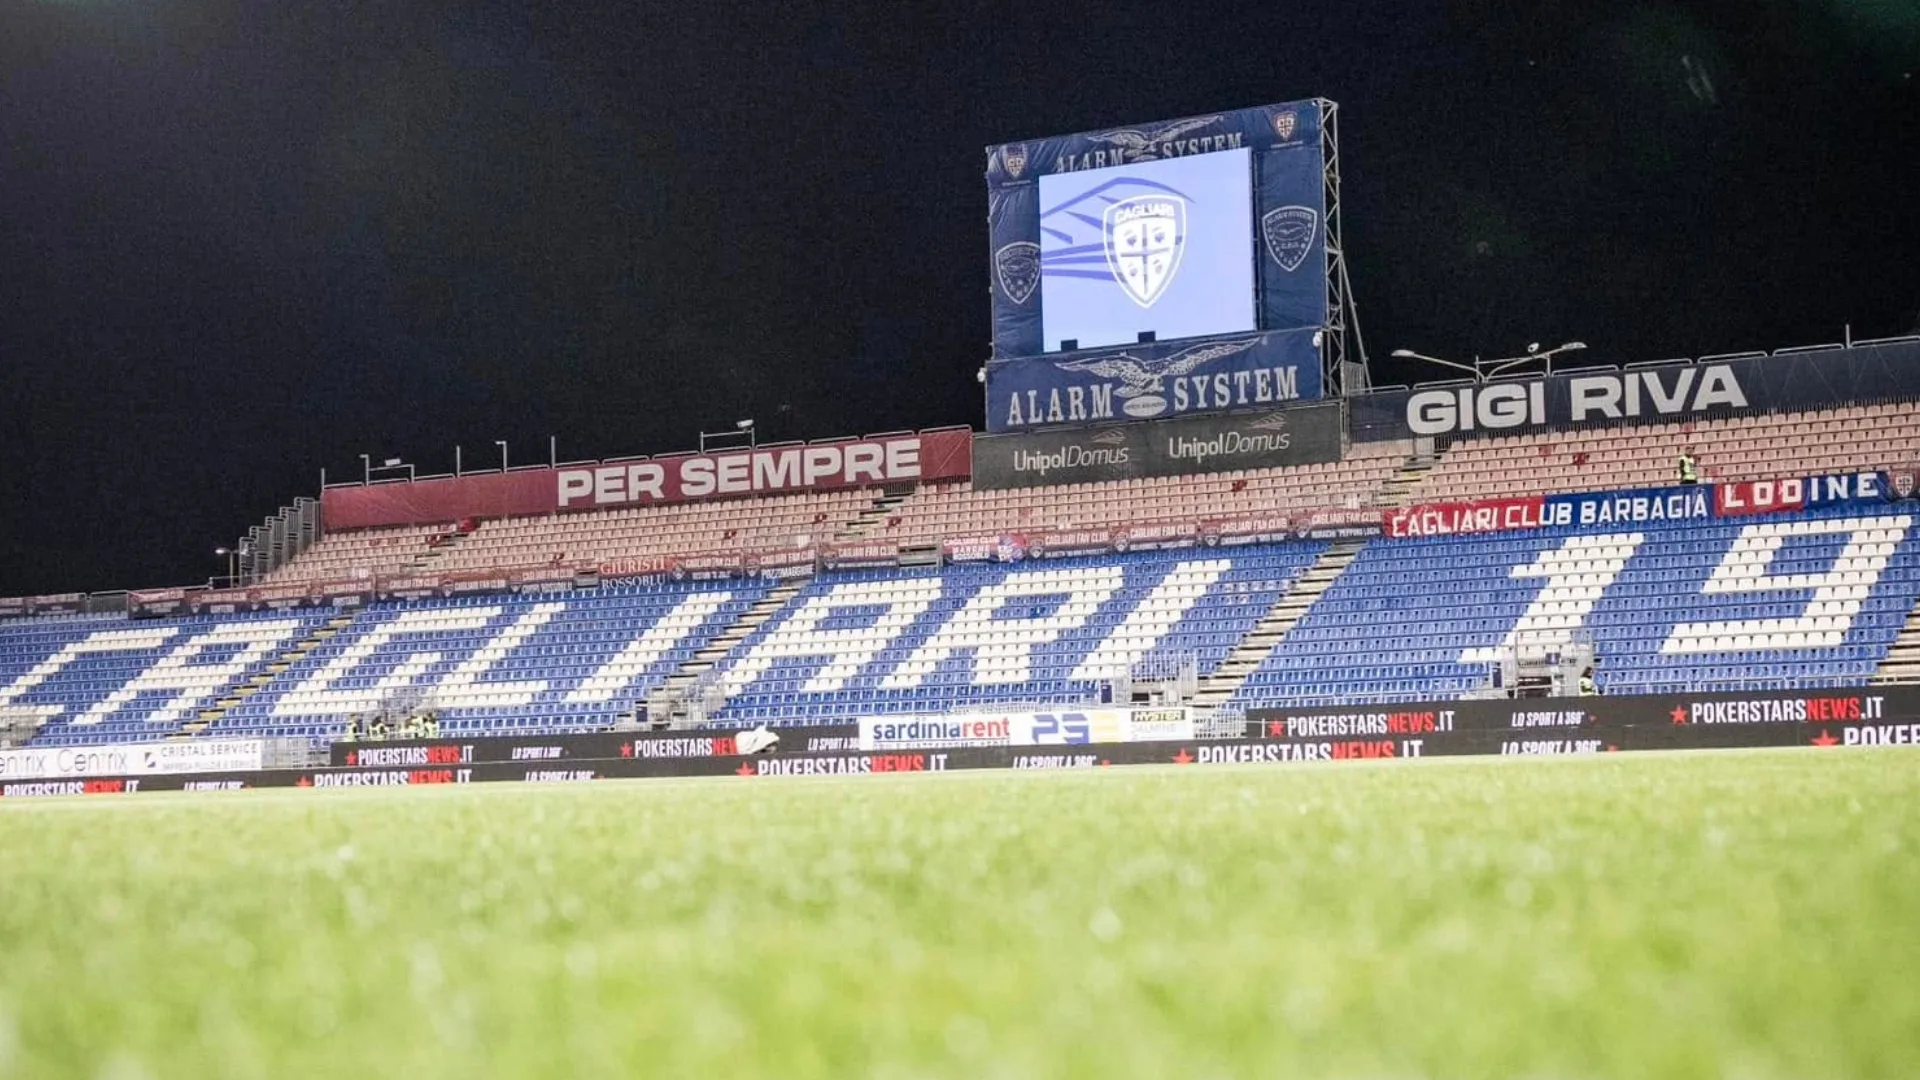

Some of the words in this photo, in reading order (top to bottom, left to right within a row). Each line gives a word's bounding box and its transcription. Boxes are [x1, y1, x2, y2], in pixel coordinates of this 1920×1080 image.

[1056, 148, 1125, 172] ALARM
[1162, 132, 1243, 159] SYSTEM
[1007, 382, 1114, 426] ALARM
[1174, 365, 1300, 412] SYSTEM
[1406, 382, 1545, 434] GIGI
[1570, 364, 1748, 421] RIVA
[1168, 432, 1291, 464] UnipolDomus
[558, 464, 664, 507] PER
[681, 439, 921, 493] SEMPRE
[1013, 446, 1129, 476] UnipolDomus
[1392, 506, 1498, 537] CAGLIARI
[1504, 503, 1572, 527] CLUB
[1579, 494, 1708, 525] BARBAGIA
[600, 555, 665, 576] GIURISTI
[602, 573, 666, 590] ROSSOBLU
[1511, 712, 1525, 727] LO
[1526, 711, 1557, 726] SPORT
[1692, 697, 1884, 724] POKERSTARSNEWS.IT
[873, 717, 1011, 740] sardiniarent
[1287, 711, 1455, 738] POKERSTARSNEWS.IT
[161, 744, 206, 758] CRISTAL
[210, 742, 258, 755] SERVICE
[357, 745, 474, 766] POKERSTARSNEWS.IT
[634, 737, 738, 758] POKERSTARSNEW
[1198, 739, 1424, 763] POKERSTARSNEWSIT
[57, 749, 129, 774] Centrix
[757, 754, 948, 777] POKERSTARSNEWSIT
[3, 779, 140, 797] POKERSTARSNEWSIT
[314, 768, 473, 788] POKERSTARSNEWSIT
